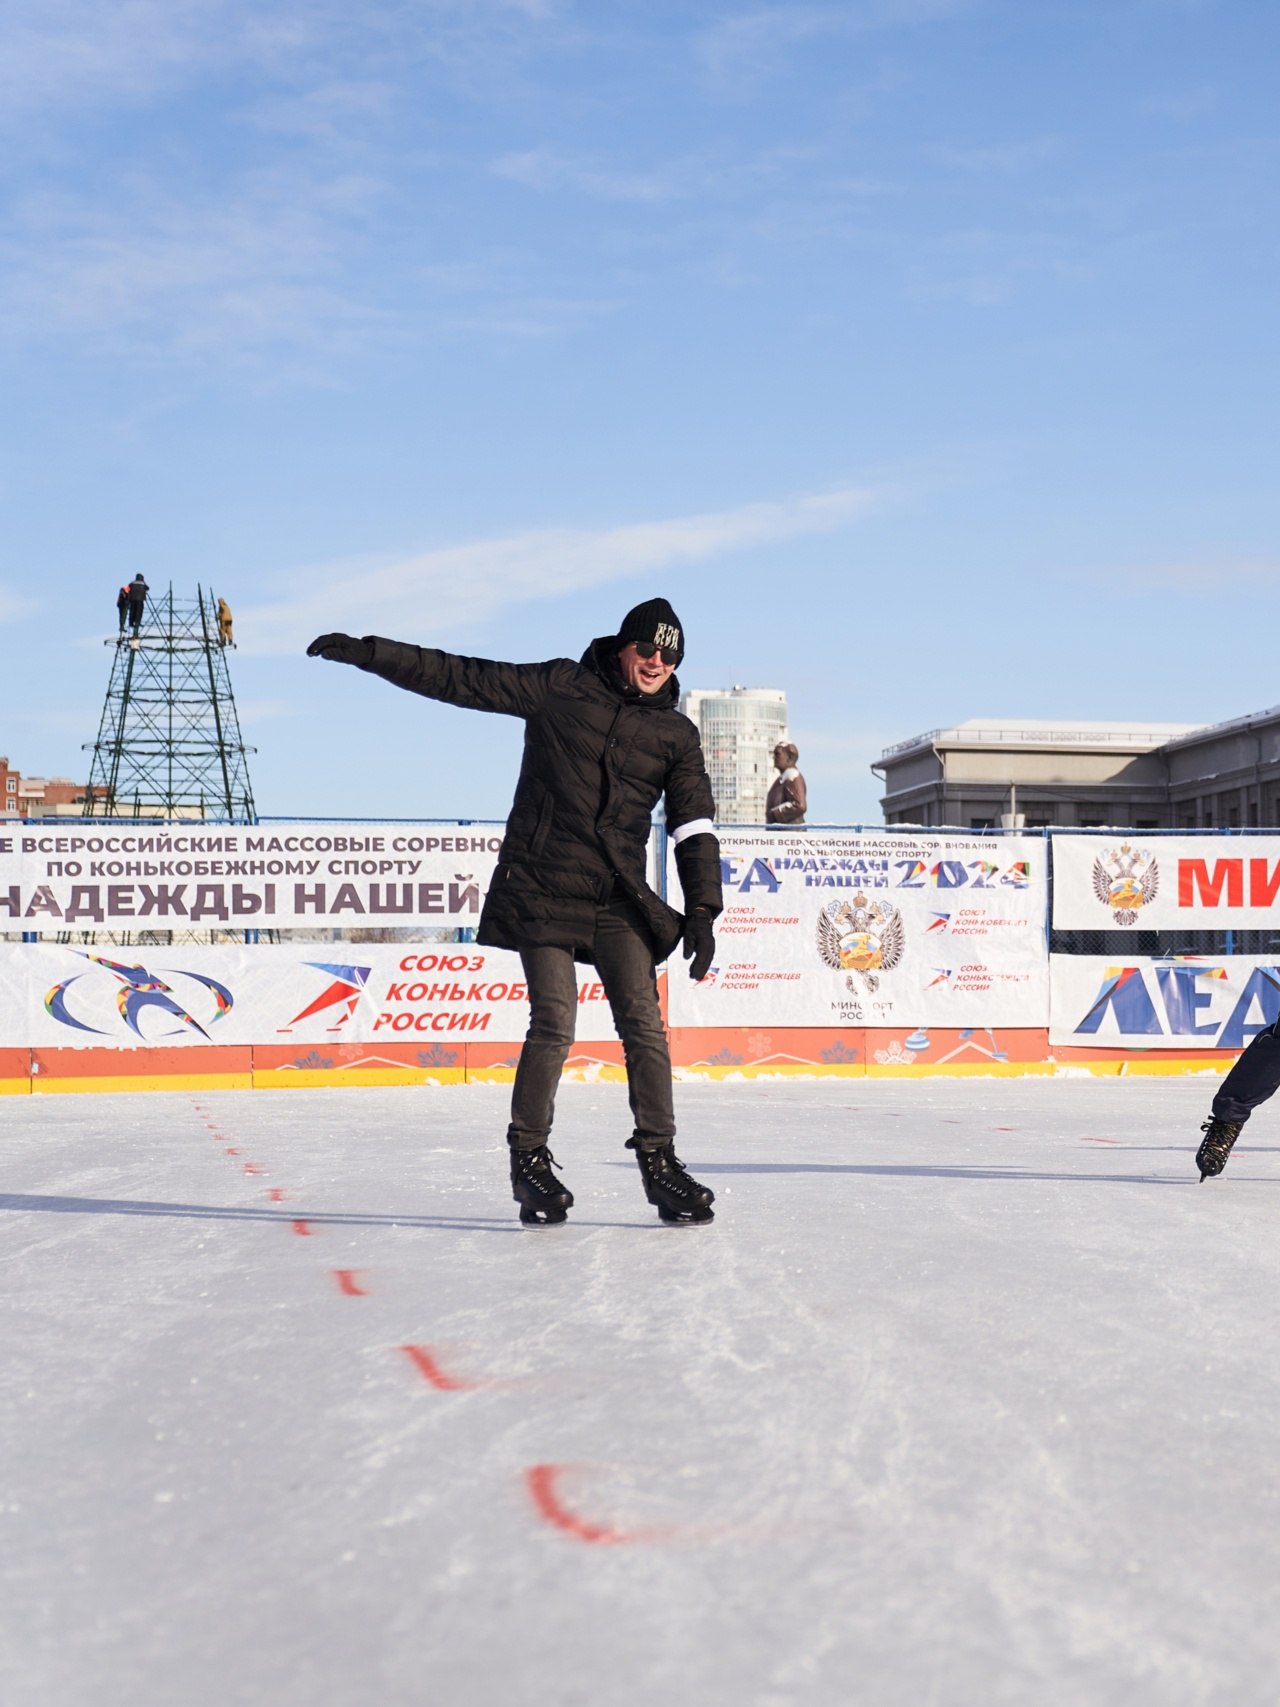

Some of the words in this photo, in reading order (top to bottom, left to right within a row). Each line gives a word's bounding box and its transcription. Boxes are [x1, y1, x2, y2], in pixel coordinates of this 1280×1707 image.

[22, 833, 238, 853] ВСЕРОССИЙСКИЕ
[246, 837, 385, 853] МАССОВЫЕ
[719, 837, 775, 846] ОТКРЫТЫЕ
[778, 838, 861, 848] ВСЕРССИЙСКИЕ
[863, 840, 918, 849] МАССОВЫЕ
[921, 841, 998, 850] СОРВНОВАНИЯ
[895, 850, 933, 858] СПОРТУ
[47, 860, 82, 877] ПО
[90, 860, 320, 876] КОНЬКОБЕЖНОМУ
[328, 860, 422, 875] СПОРТУ
[775, 858, 888, 874] НАДЕЖДЫ
[805, 872, 888, 889] НАШЕЙ
[294, 874, 480, 914] НАШЕЙ
[723, 917, 800, 925] КОНЬКОБЕЖЦЕВ
[399, 955, 485, 971] СОЮЗ
[724, 973, 801, 981] КОНЬКОБЕЖЦЕВ
[372, 1013, 492, 1031] РОССИИ
